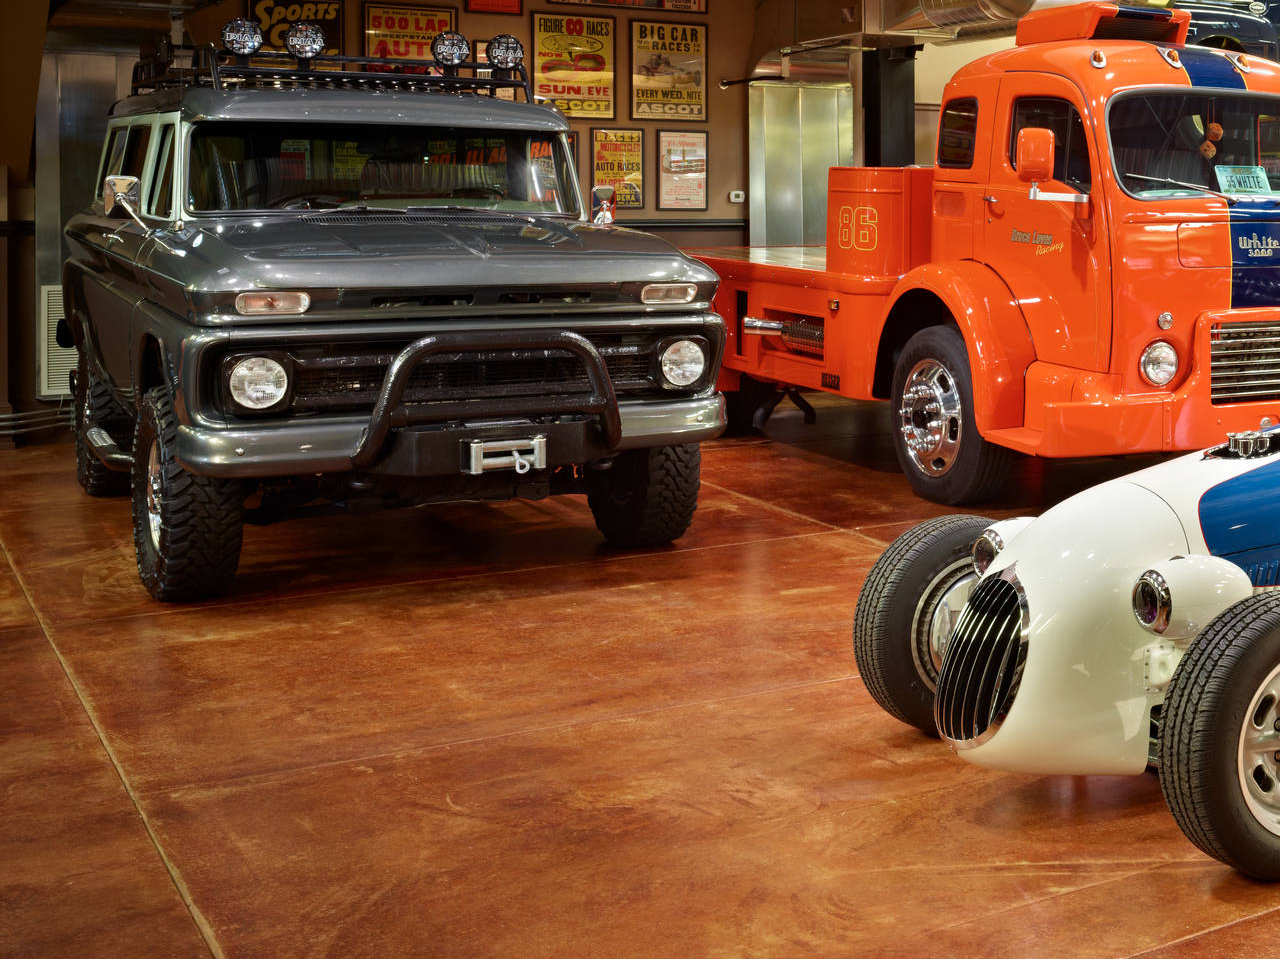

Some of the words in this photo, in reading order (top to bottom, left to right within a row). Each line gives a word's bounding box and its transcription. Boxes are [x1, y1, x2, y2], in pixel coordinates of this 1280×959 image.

[255, 0, 340, 32] SPORTS
[371, 16, 409, 31] 500
[414, 18, 449, 33] LAP
[538, 17, 565, 34] FIGURE
[586, 21, 610, 37] RACES
[639, 24, 666, 41] BIG
[670, 27, 699, 43] CAR
[289, 36, 325, 47] PIAA
[652, 41, 691, 52] RACES
[373, 39, 432, 58] AUT
[437, 44, 470, 54] PIAA
[492, 48, 524, 58] PIAA
[538, 84, 585, 96] SUN.
[587, 86, 609, 96] EVE
[636, 89, 659, 99] EVERY
[660, 90, 685, 100] WED.
[686, 91, 702, 101] NITE
[638, 103, 702, 115] ASCOT
[596, 162, 615, 172] AUTO
[617, 162, 641, 172] RACES
[1236, 174, 1263, 189] WHITE
[838, 205, 878, 251] 86
[1238, 232, 1280, 249] White
[1247, 248, 1273, 257] 3000
